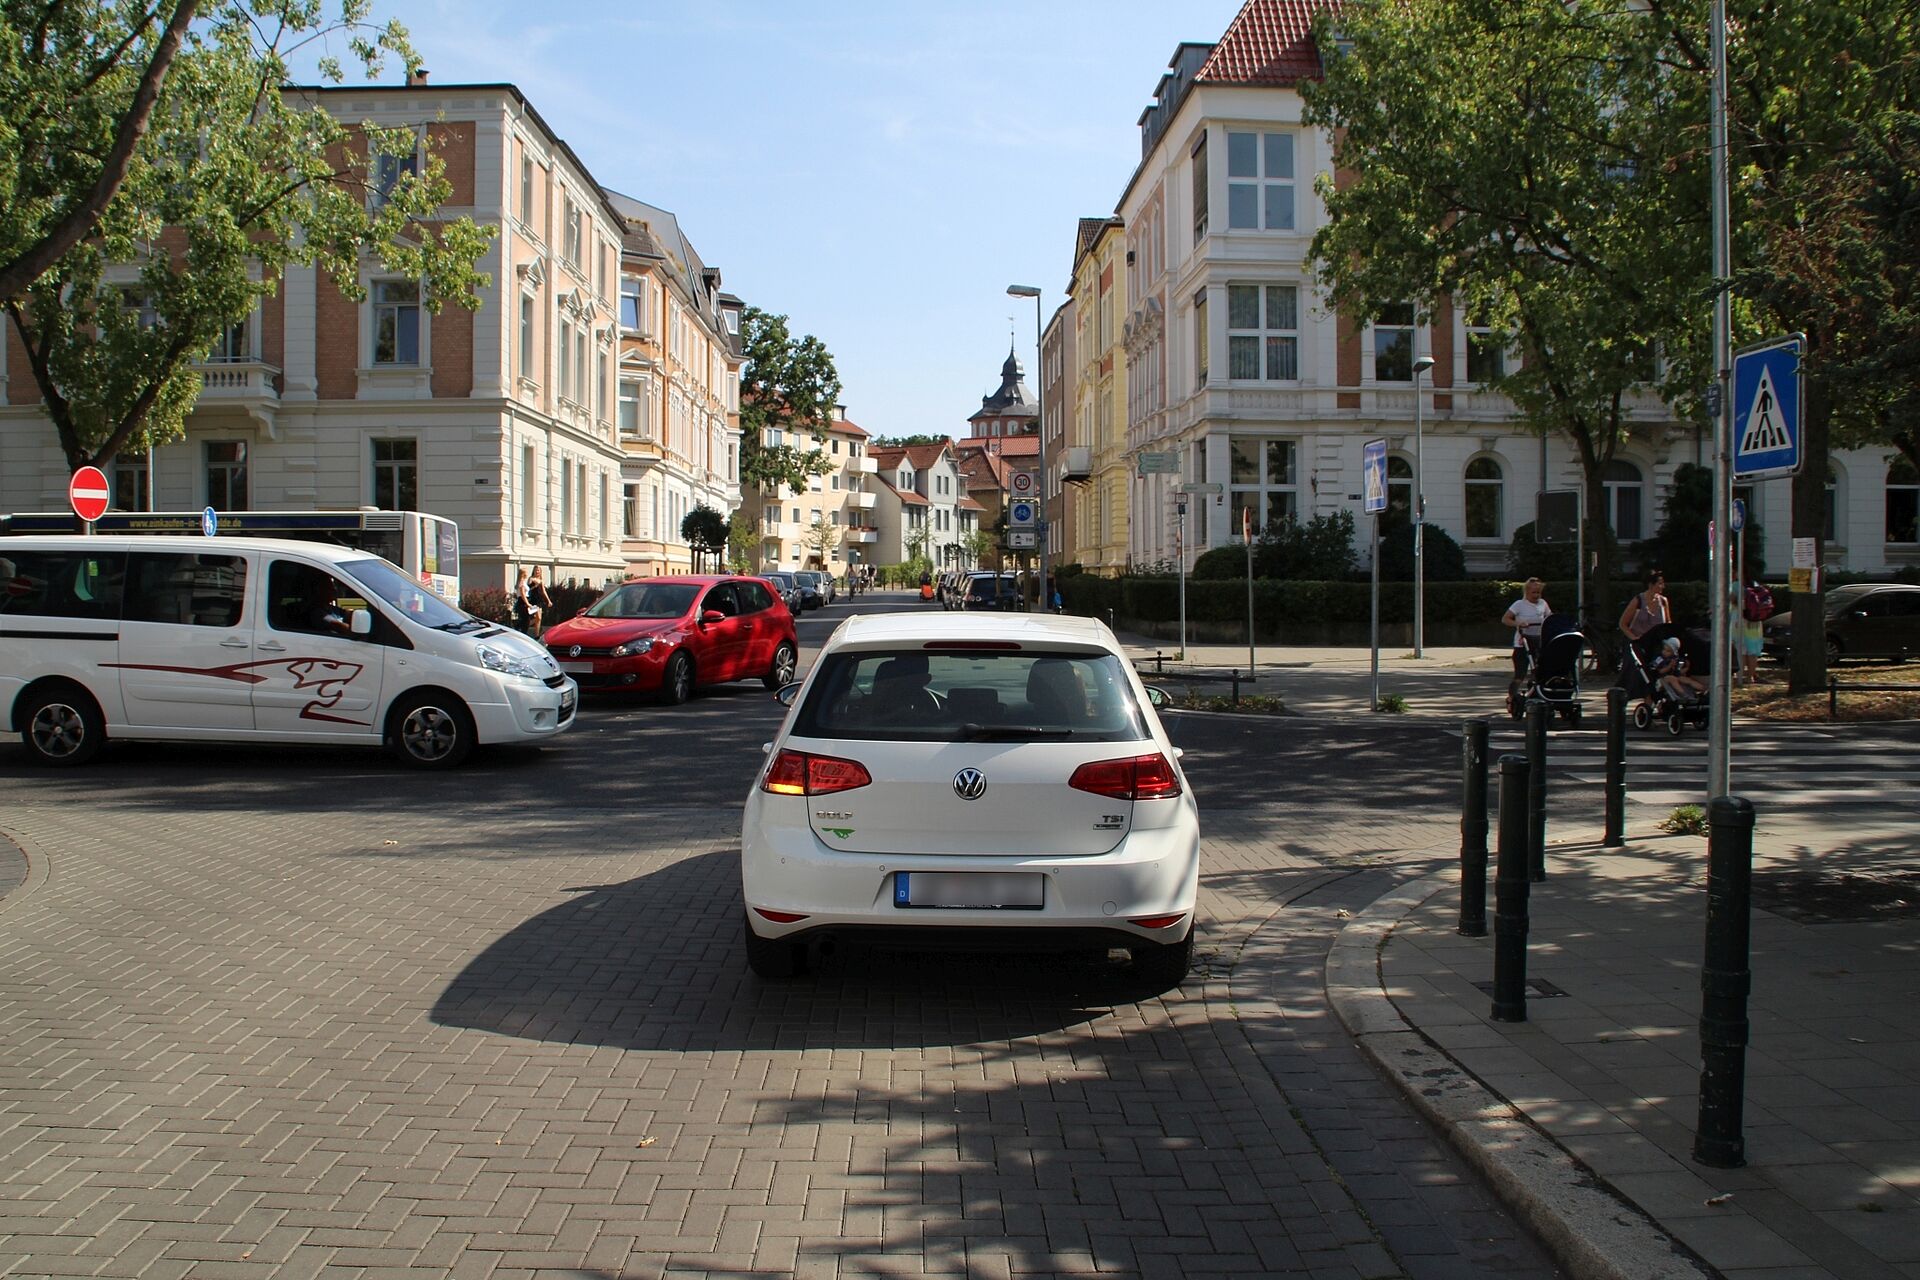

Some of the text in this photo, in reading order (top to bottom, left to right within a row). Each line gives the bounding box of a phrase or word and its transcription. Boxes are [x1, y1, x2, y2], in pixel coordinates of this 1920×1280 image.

[1017, 478, 1028, 486] 30
[953, 768, 986, 800] VW
[816, 810, 853, 819] GOLF
[1102, 815, 1124, 823] TSI
